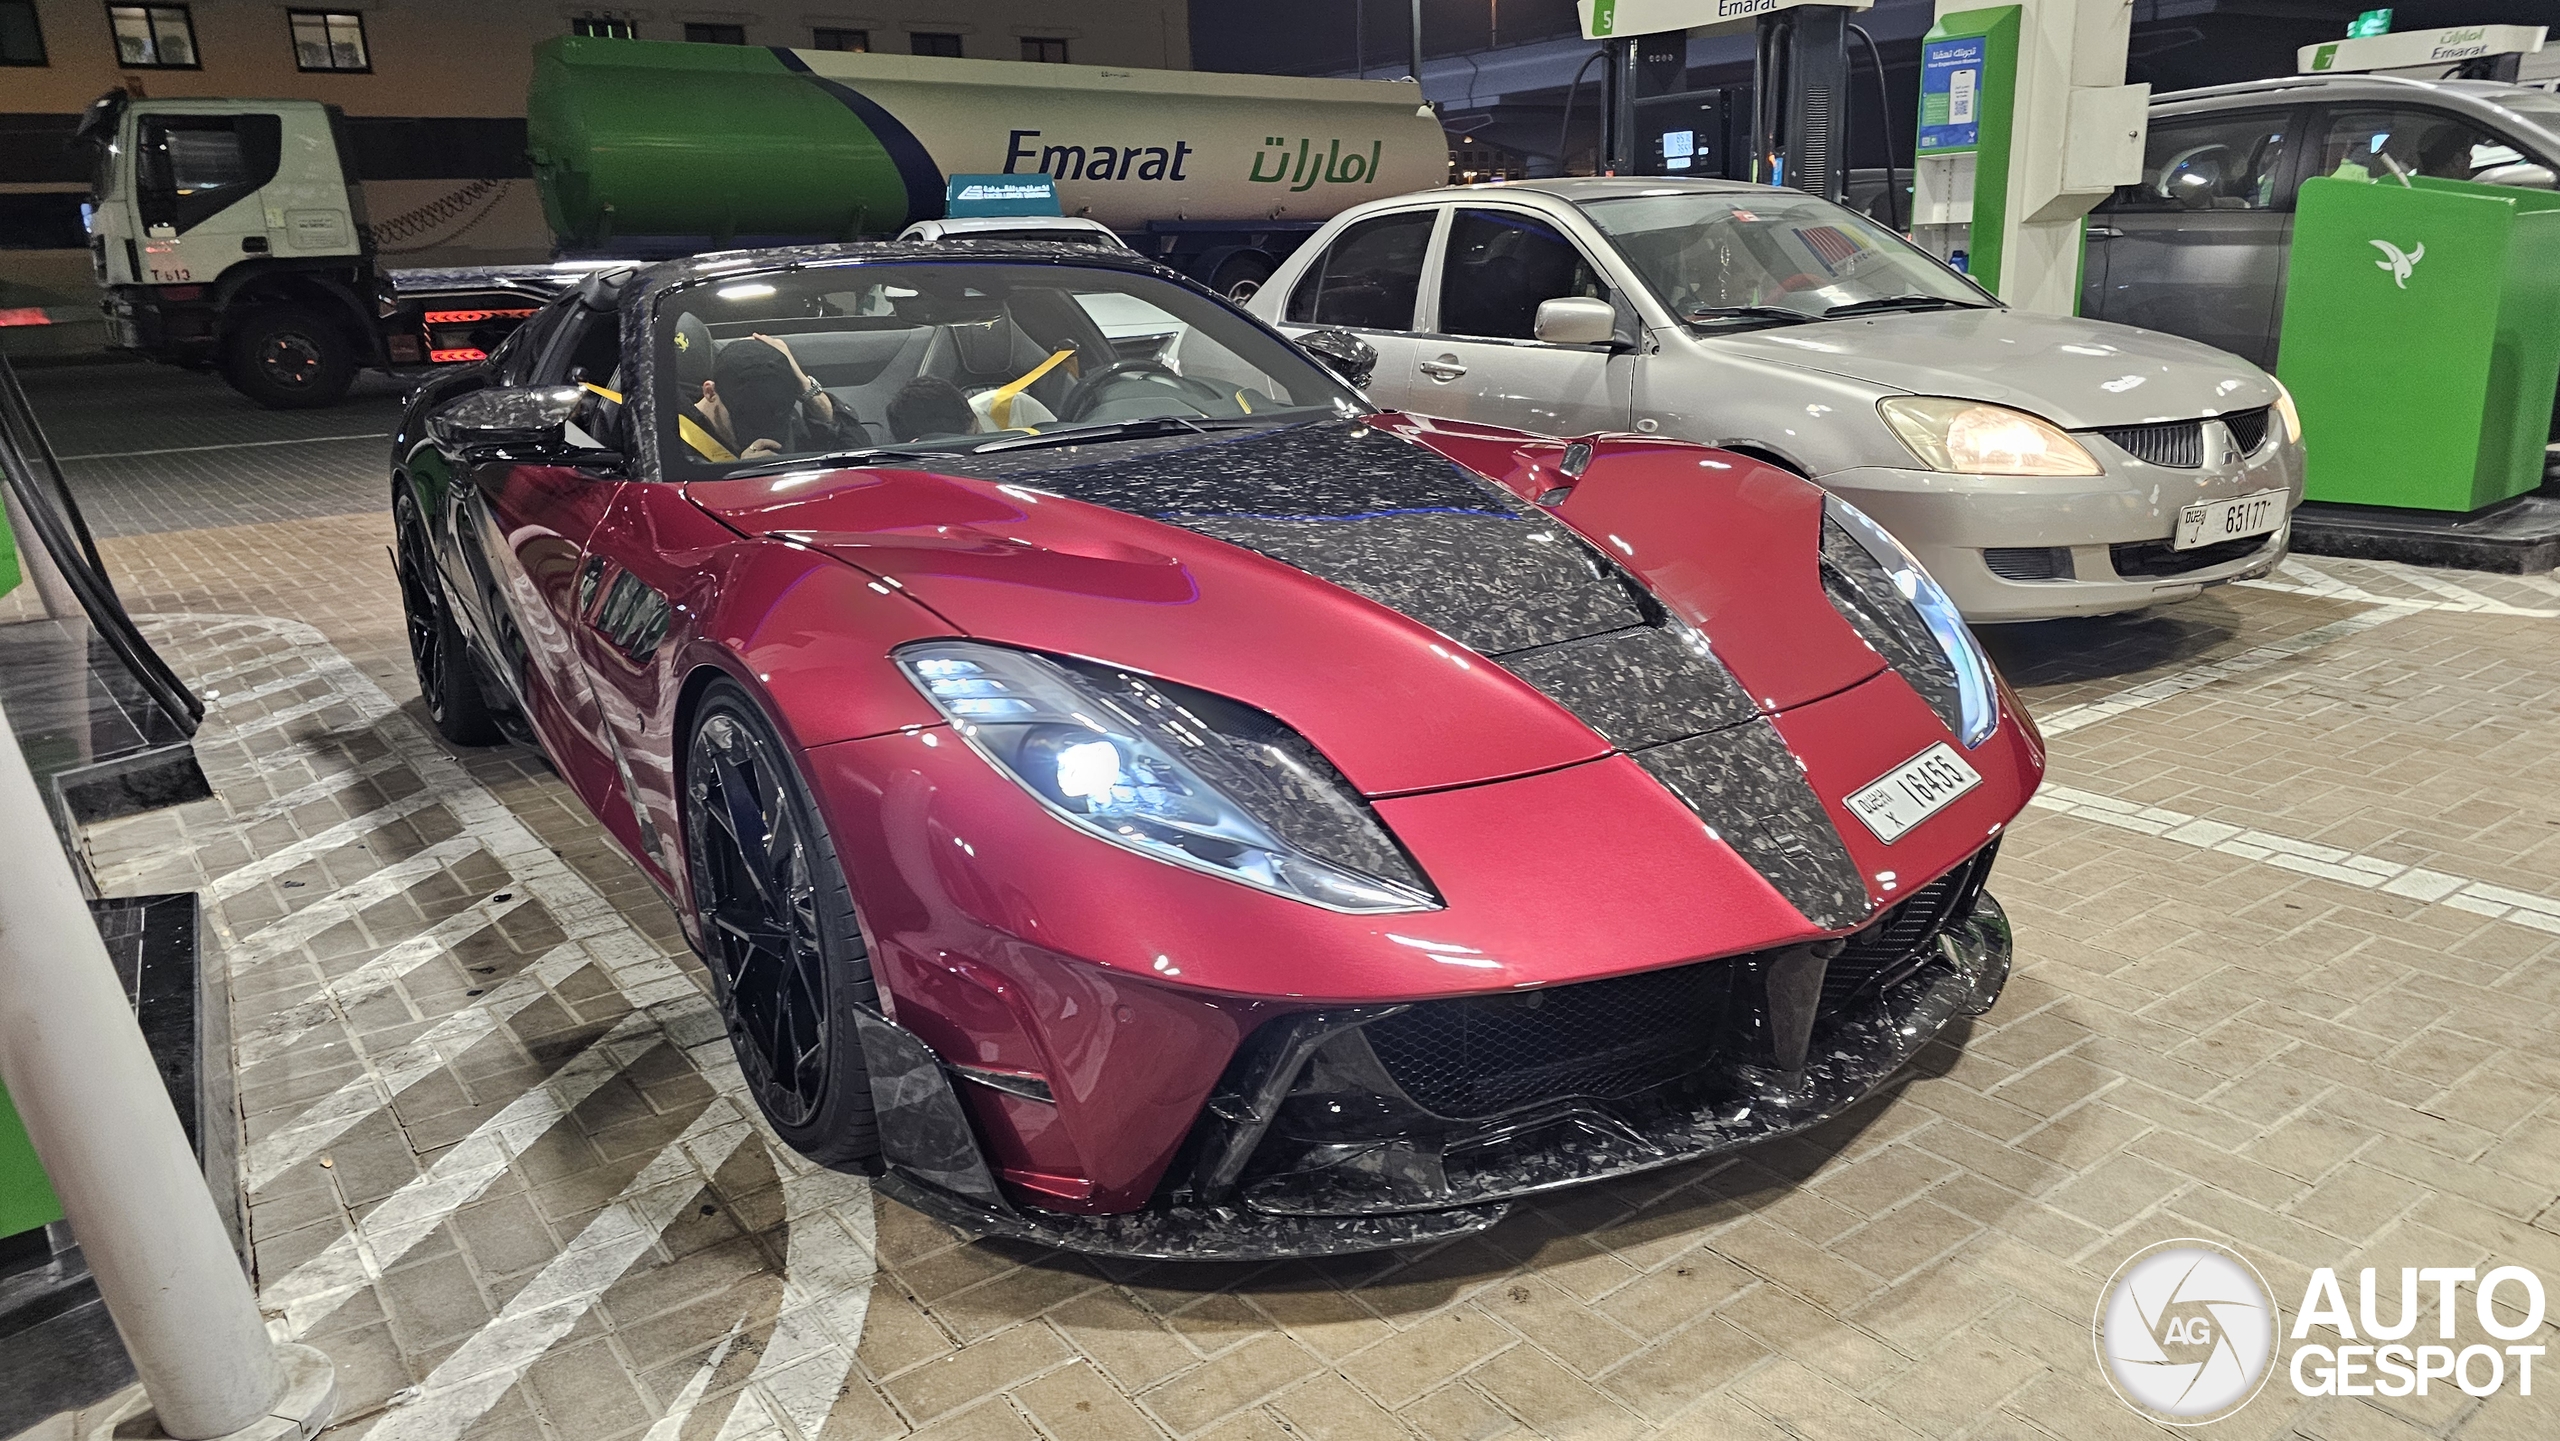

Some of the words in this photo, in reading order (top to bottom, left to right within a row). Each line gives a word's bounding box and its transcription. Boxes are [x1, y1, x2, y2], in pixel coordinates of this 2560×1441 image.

[1603, 10, 1612, 29] 5
[2324, 54, 2334, 67] 7
[2431, 44, 2489, 60] Emarat
[1003, 130, 1192, 181] Emarat
[1248, 136, 1382, 192] امارات
[2226, 500, 2267, 533] 65177
[2191, 526, 2200, 544] J
[1896, 754, 1965, 808] 16455
[1884, 811, 1905, 829] X
